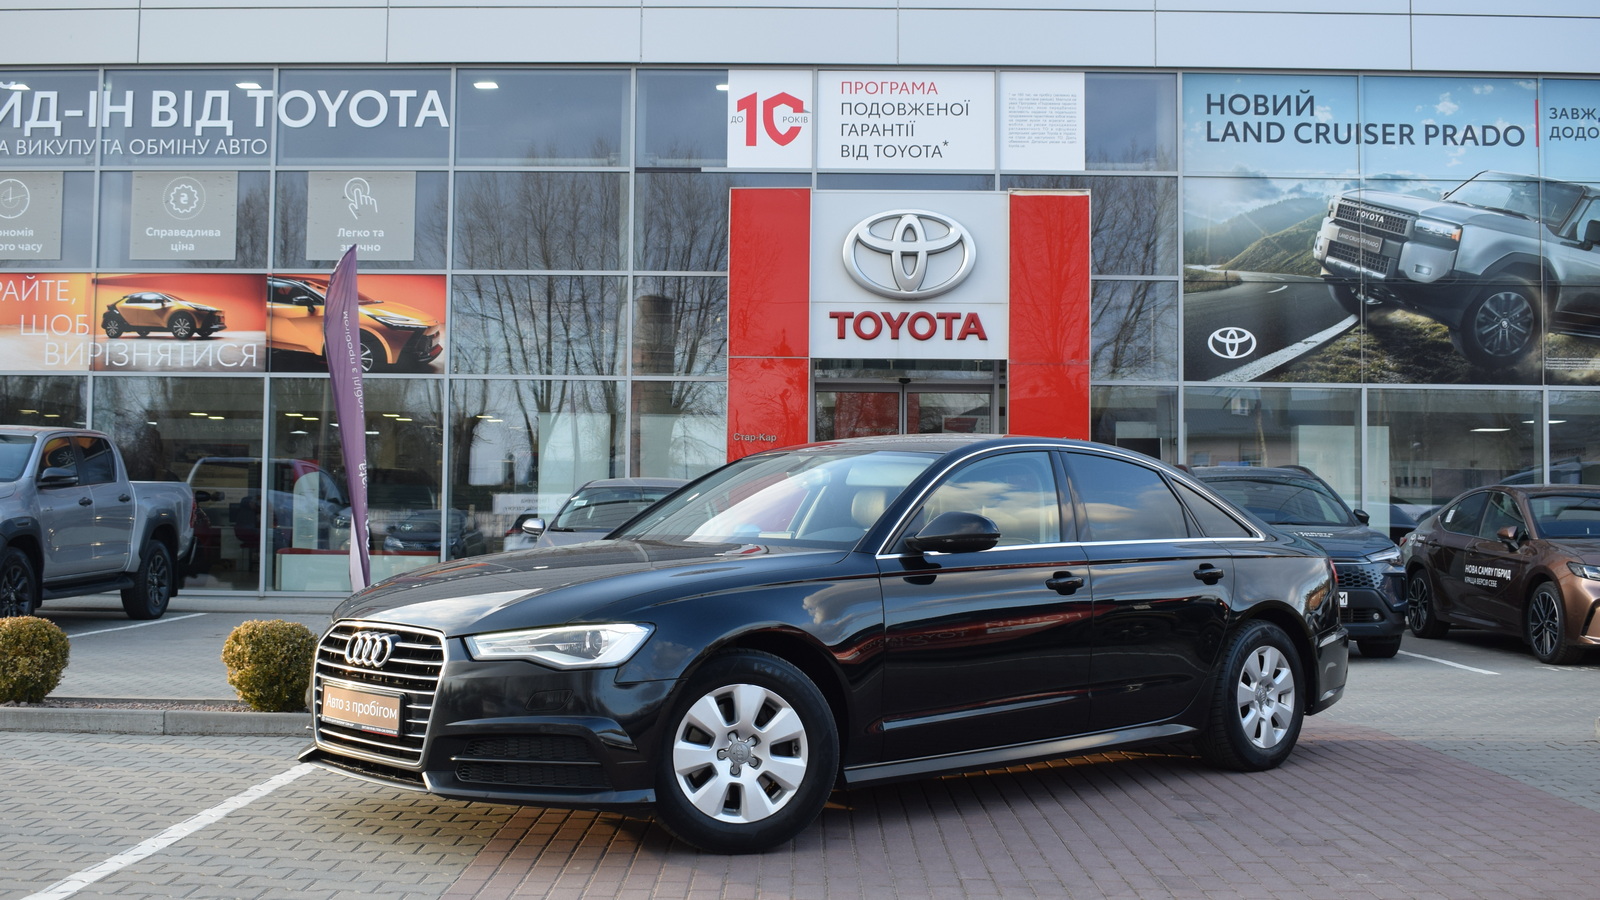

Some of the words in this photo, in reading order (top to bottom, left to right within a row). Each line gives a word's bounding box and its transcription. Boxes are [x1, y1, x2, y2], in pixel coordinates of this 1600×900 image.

[841, 81, 939, 95] ПРОГРАМА
[841, 99, 971, 119] ПОДОВЖЕНОЇ
[1205, 88, 1316, 117] НОВИЙ
[151, 90, 233, 136] ВІД
[247, 90, 450, 128] TOYOTA
[731, 115, 744, 124] ДО
[782, 115, 809, 124] РОКІВ
[1549, 107, 1600, 123] ЗАВЖ
[841, 120, 916, 137] ГАРАНТІЇ
[1205, 120, 1286, 143] LAND
[1294, 122, 1416, 146] CRUISER
[1424, 124, 1526, 148] PRADO
[16, 139, 96, 156] ВИКУПУ
[101, 139, 124, 156] ТА
[129, 138, 211, 156] ОБМІНУ
[214, 139, 268, 155] АВТО
[841, 144, 869, 160] ВІД
[1356, 210, 1384, 222] TOYOTA
[145, 227, 222, 239] Справедлива
[337, 227, 371, 238] Легко
[372, 229, 385, 238] та
[18, 243, 43, 253] часу
[170, 241, 196, 253] ціна
[19, 313, 90, 338] ЩОБ
[829, 311, 988, 341] TOYOTA
[44, 342, 258, 368] ВИРІЗНЯТИСЯ
[733, 432, 777, 443] Стар-Кар
[1465, 564, 1477, 573] НОВА
[1478, 566, 1494, 576] CAMRY
[326, 693, 344, 710] Авто
[345, 700, 350, 711] з
[352, 701, 397, 719] пробігом
